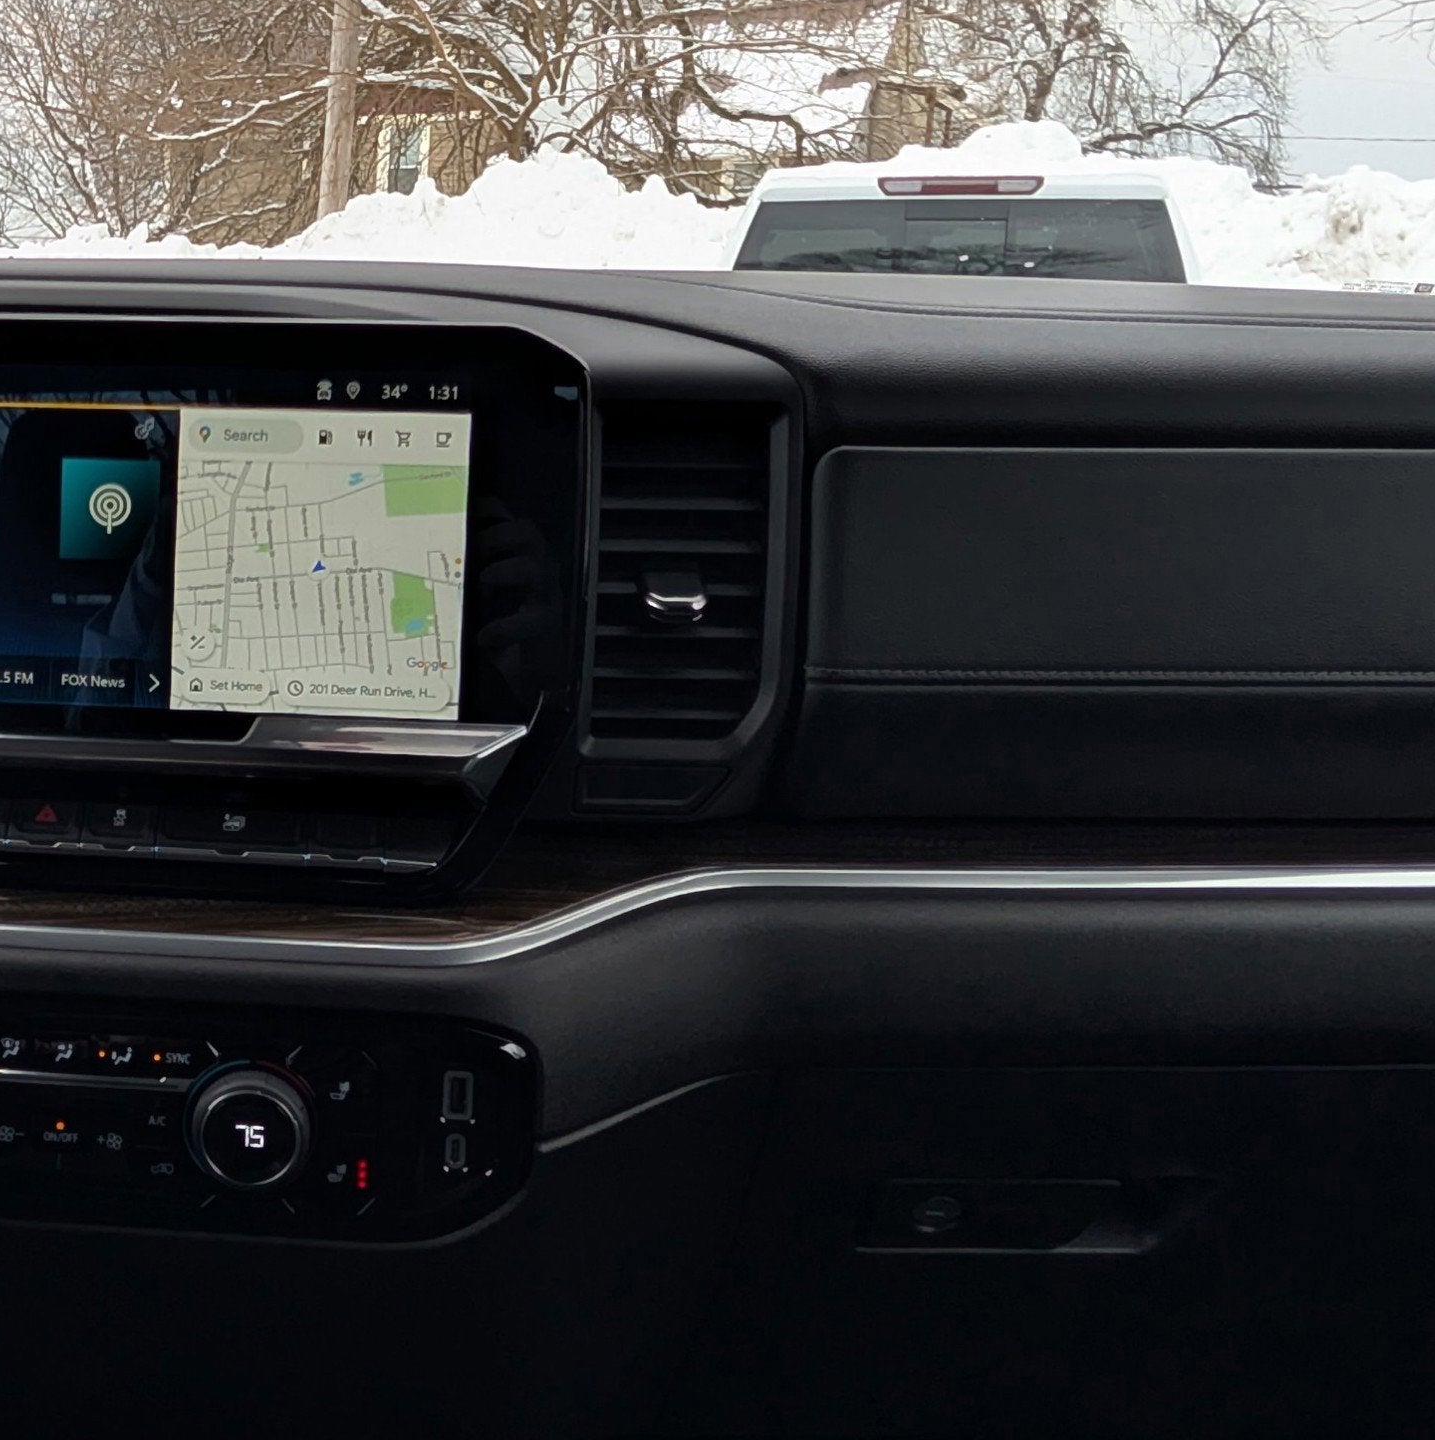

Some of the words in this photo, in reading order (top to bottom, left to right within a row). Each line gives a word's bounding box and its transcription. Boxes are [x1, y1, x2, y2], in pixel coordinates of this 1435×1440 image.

[429, 385, 459, 400] 1:31
[223, 428, 269, 442] Search
[406, 656, 448, 671] Google
[14, 671, 34, 685] FM
[61, 673, 89, 687] FOX
[90, 674, 126, 689] News
[209, 680, 230, 691] Set
[231, 681, 264, 692] Home
[309, 684, 329, 695] 201
[331, 684, 358, 695] Deer
[360, 686, 382, 696] Run
[384, 686, 416, 698] Drive,
[165, 1052, 192, 1064] SYNC
[147, 1115, 167, 1127] A/C
[42, 1131, 79, 1145] ON/OFF
[234, 1123, 265, 1150] 75
